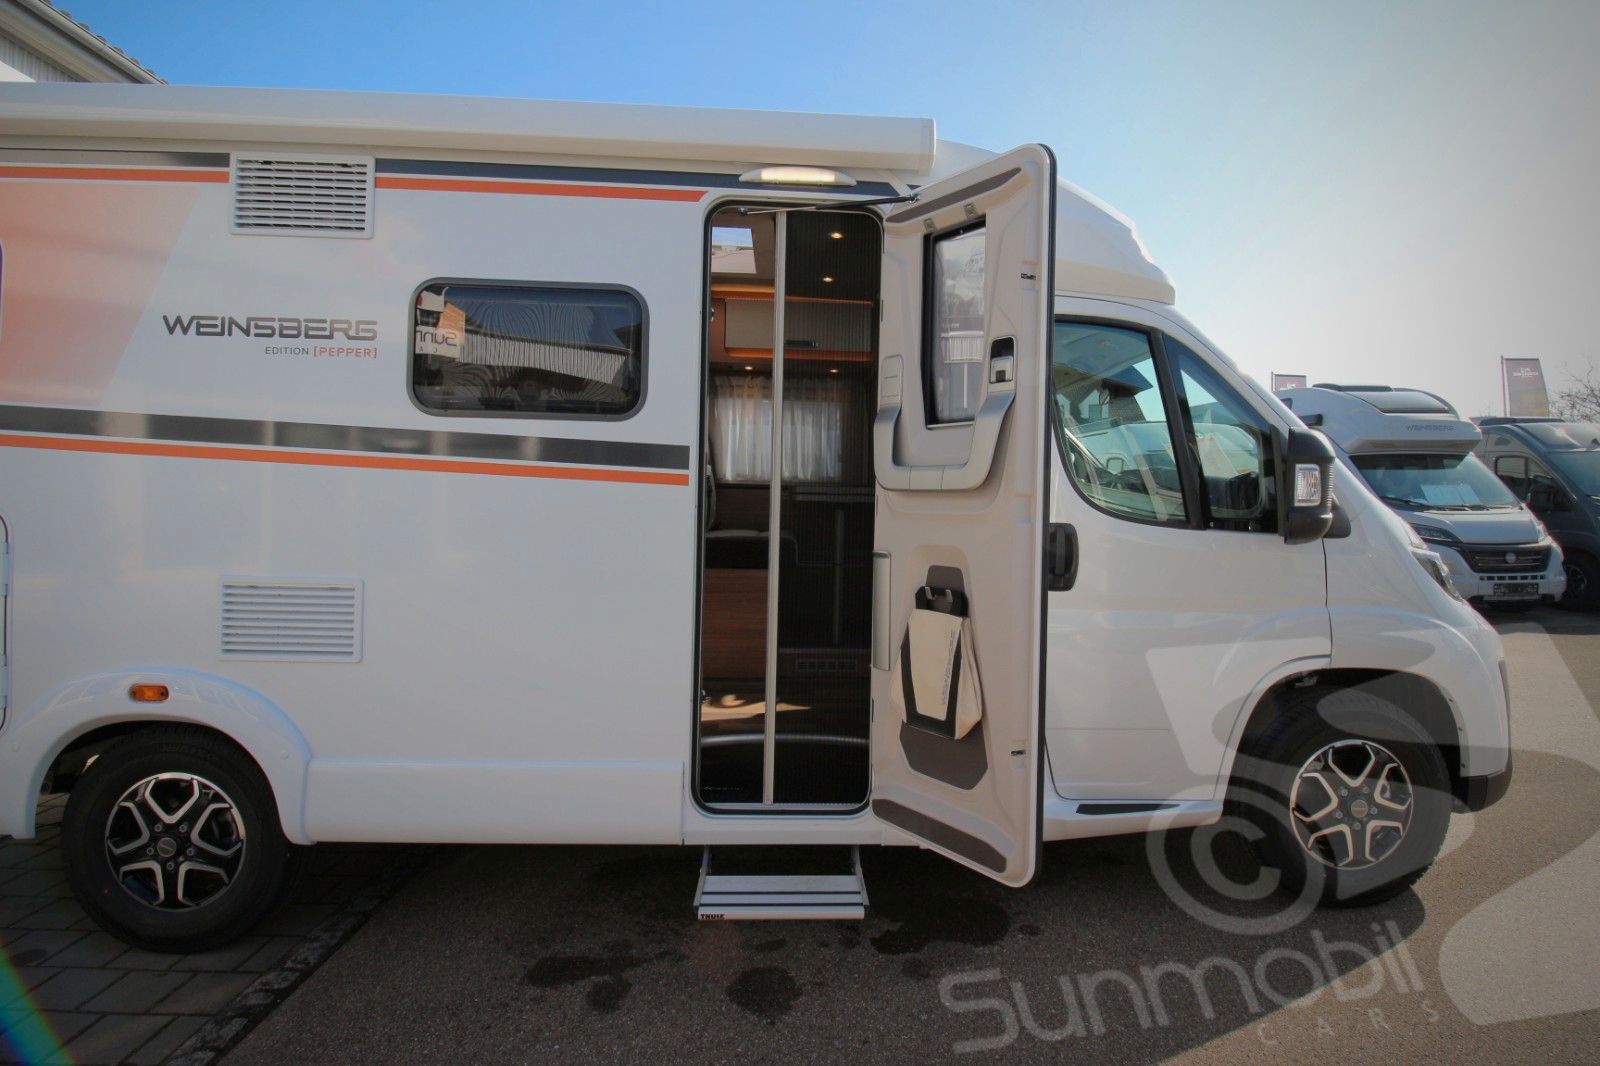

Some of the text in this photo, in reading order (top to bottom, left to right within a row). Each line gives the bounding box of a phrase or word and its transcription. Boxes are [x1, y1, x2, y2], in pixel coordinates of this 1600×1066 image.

[162, 314, 378, 341] WEINSBERG
[264, 346, 378, 359] EDITION [PEPPER]
